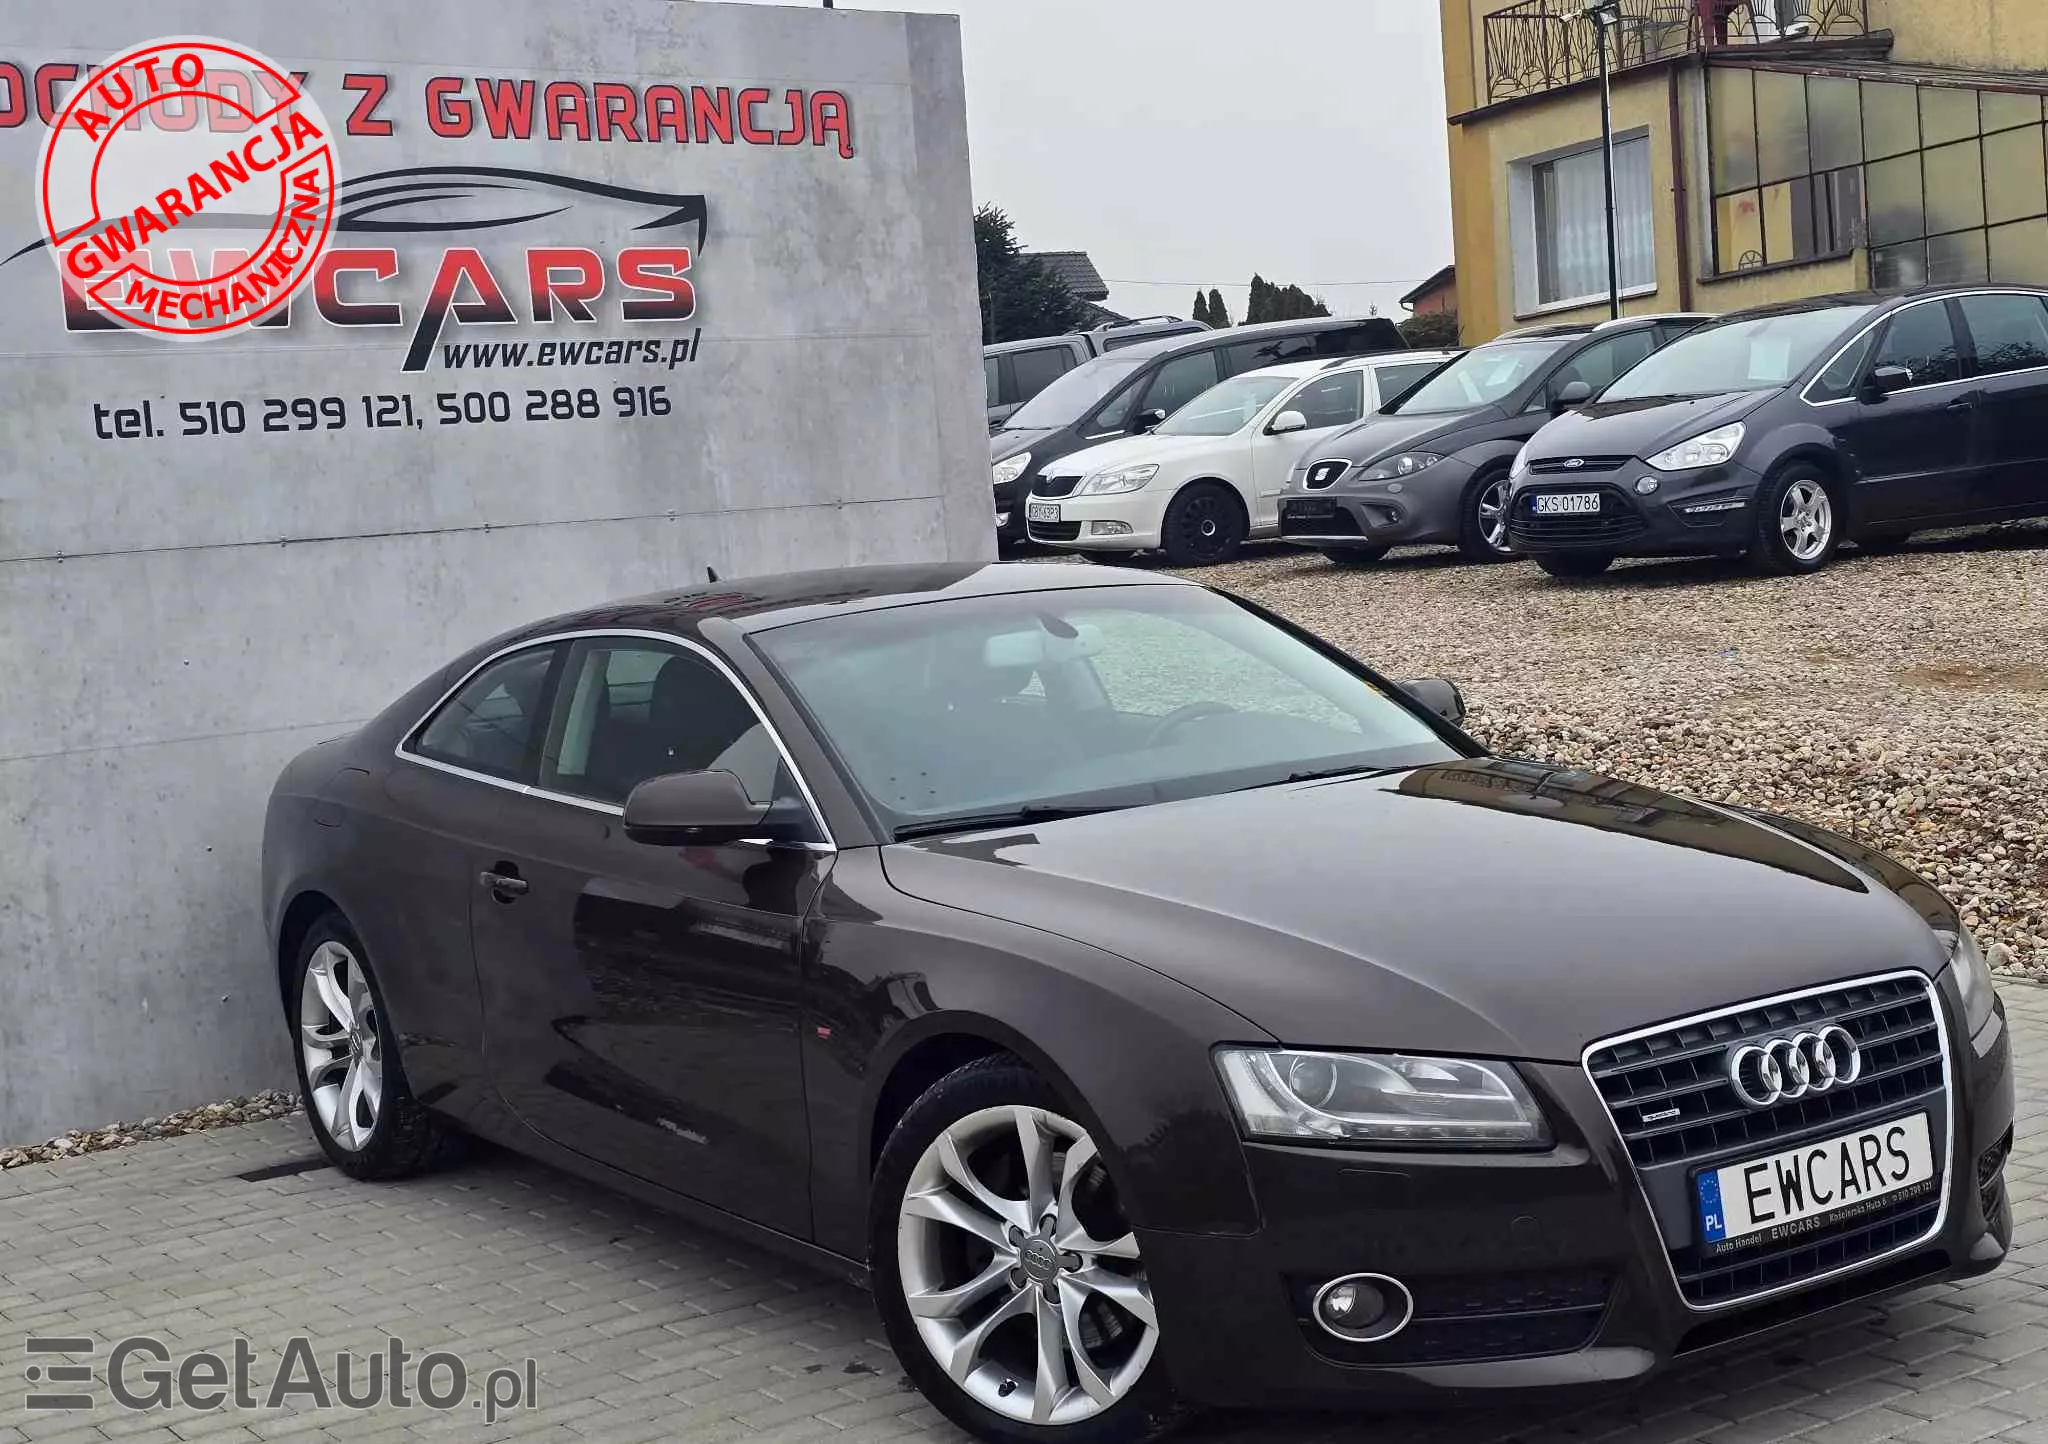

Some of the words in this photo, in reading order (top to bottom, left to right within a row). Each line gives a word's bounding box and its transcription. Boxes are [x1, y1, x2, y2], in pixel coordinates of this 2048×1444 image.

[343, 73, 393, 136] Z
[425, 76, 856, 159] GWARANCJĄ
[443, 328, 702, 369] www.ewcars.pl
[93, 400, 164, 439] tel.
[179, 401, 246, 436] 510
[263, 397, 347, 432] 299
[362, 395, 423, 431] 121,
[437, 391, 511, 425] 500
[526, 388, 601, 421] 288
[613, 385, 672, 418] 916
[1537, 496, 1559, 512] GKS
[1562, 494, 1599, 511] 01786
[1744, 1126, 1910, 1224] EWCARS
[1705, 1213, 1723, 1232] PL
[1771, 1217, 1821, 1240] EWCARS
